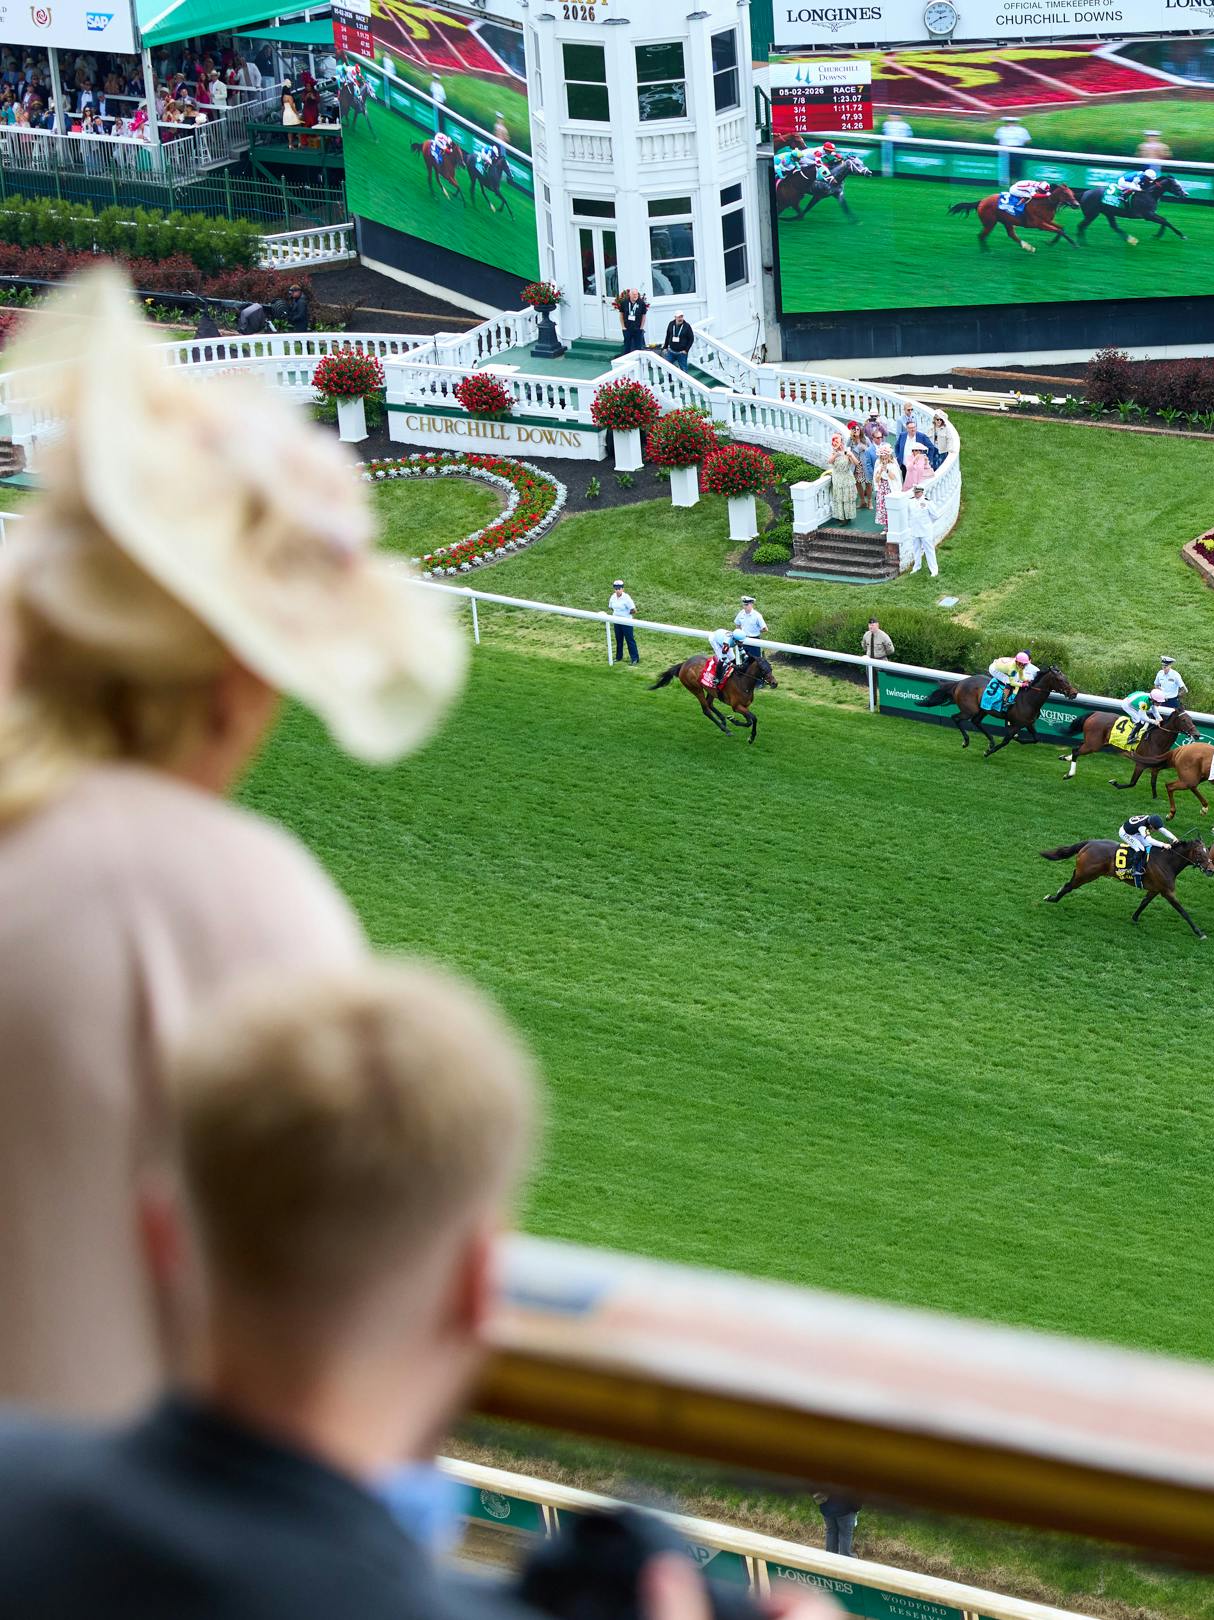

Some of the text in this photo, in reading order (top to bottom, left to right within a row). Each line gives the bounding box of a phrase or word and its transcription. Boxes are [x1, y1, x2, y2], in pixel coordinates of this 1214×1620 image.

[1003, 2, 1042, 10] OFFICIAL
[1045, 0, 1101, 8] TIMEKEEPER
[563, 4, 595, 21] 2026
[786, 6, 882, 23] LONGINES
[995, 10, 1123, 26] CHURCHILL DOWNS
[87, 14, 109, 28] SAP
[818, 65, 859, 73] CHURCHILL
[779, 85, 864, 96] 05-02-2026 RACE 7
[833, 95, 862, 103] 1:23.07
[793, 104, 863, 114] 3/4 1:11.72
[794, 113, 863, 123] 1/2 47.93
[795, 122, 864, 132] 1/4 24.26
[1106, 183, 1118, 195] 5
[1000, 191, 1011, 205] 3
[405, 415, 582, 448] CHURCHILL DOWNS
[986, 681, 1000, 696] 9
[1116, 719, 1129, 734] 4
[1115, 848, 1128, 869] 6
[776, 1566, 854, 1595] LONGINES
[880, 1592, 948, 1616] WOODFORD
[889, 1605, 945, 1620] RESERV
